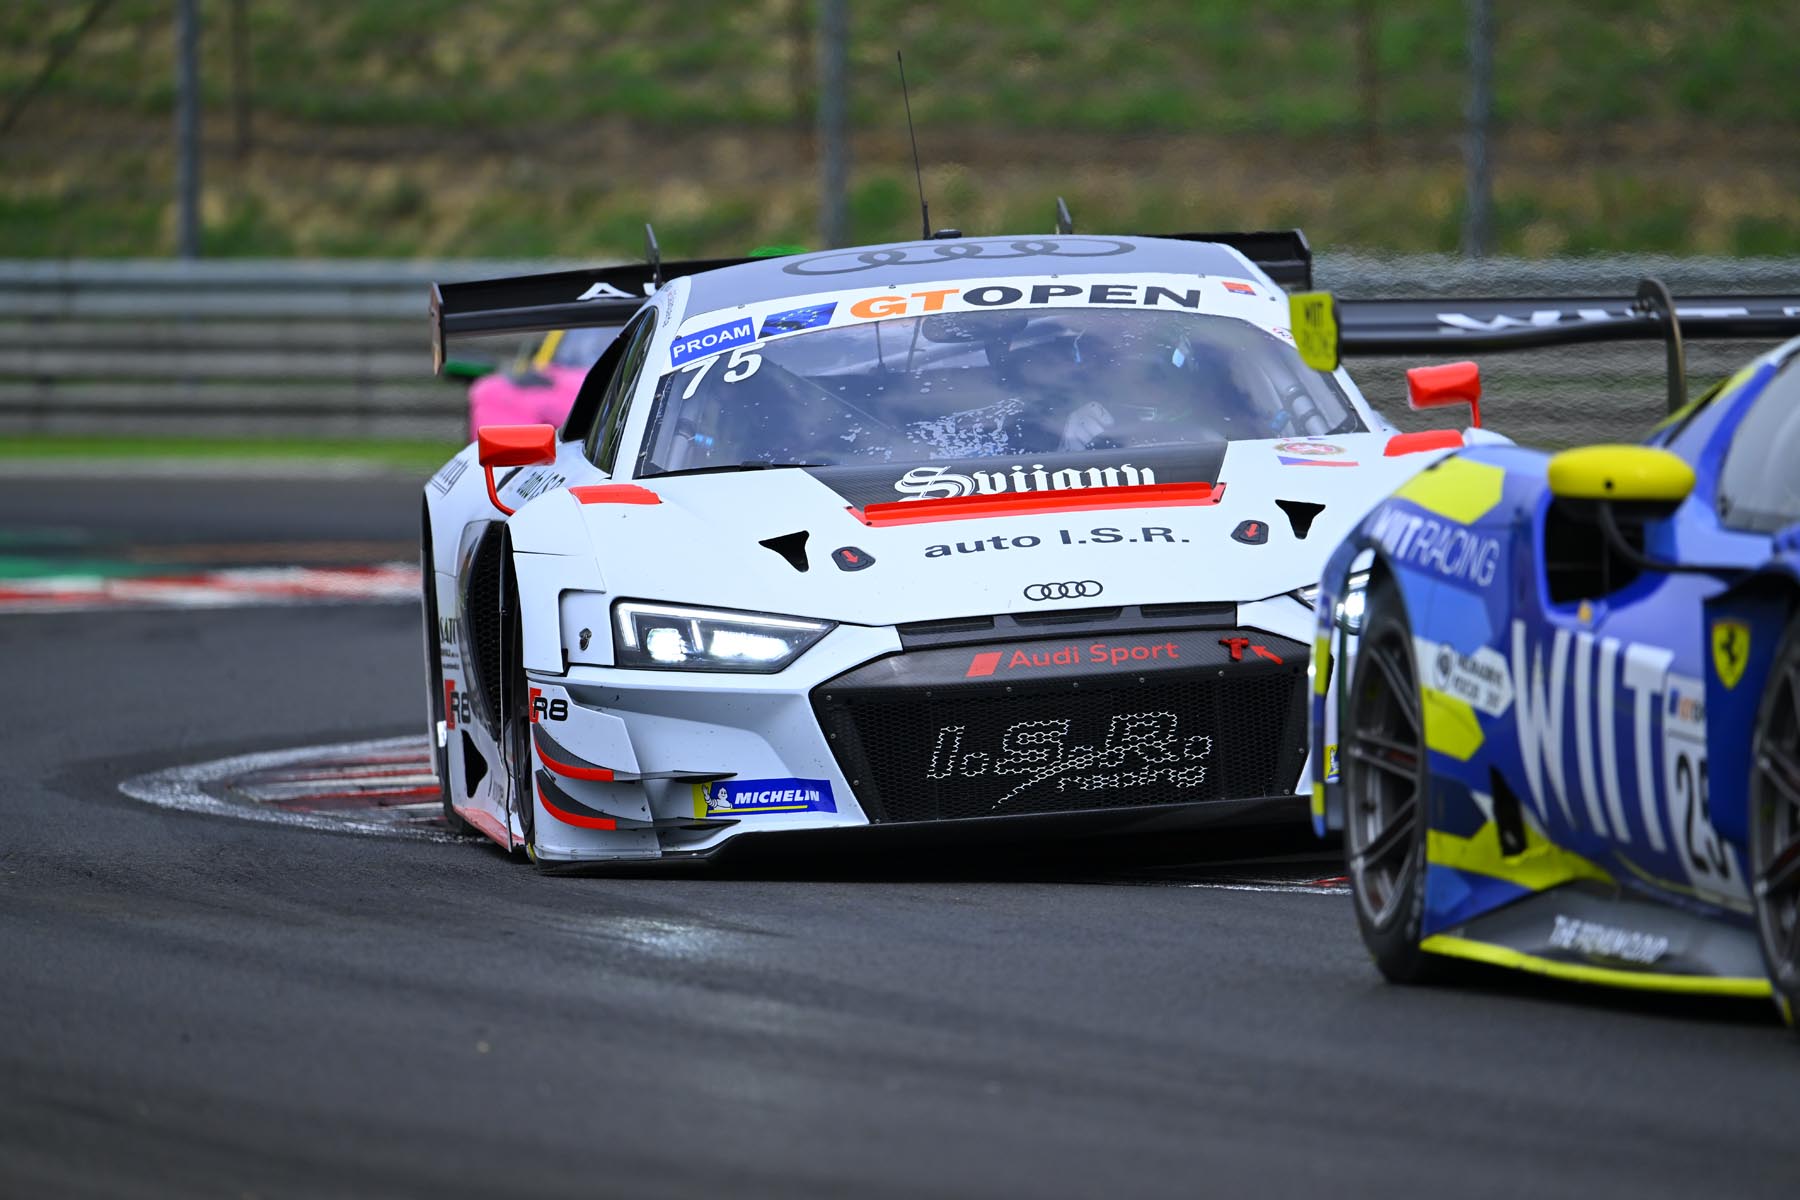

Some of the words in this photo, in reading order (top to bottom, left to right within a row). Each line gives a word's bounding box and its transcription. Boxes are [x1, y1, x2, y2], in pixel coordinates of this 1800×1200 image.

[672, 324, 751, 359] PROAM
[681, 342, 766, 400] 75
[924, 535, 1042, 559] auto
[1059, 527, 1191, 545] I.S.R.
[1008, 646, 1080, 669] Audi
[1089, 641, 1180, 666] Sport
[532, 696, 569, 722] R8
[734, 789, 820, 805] MICHELIN
